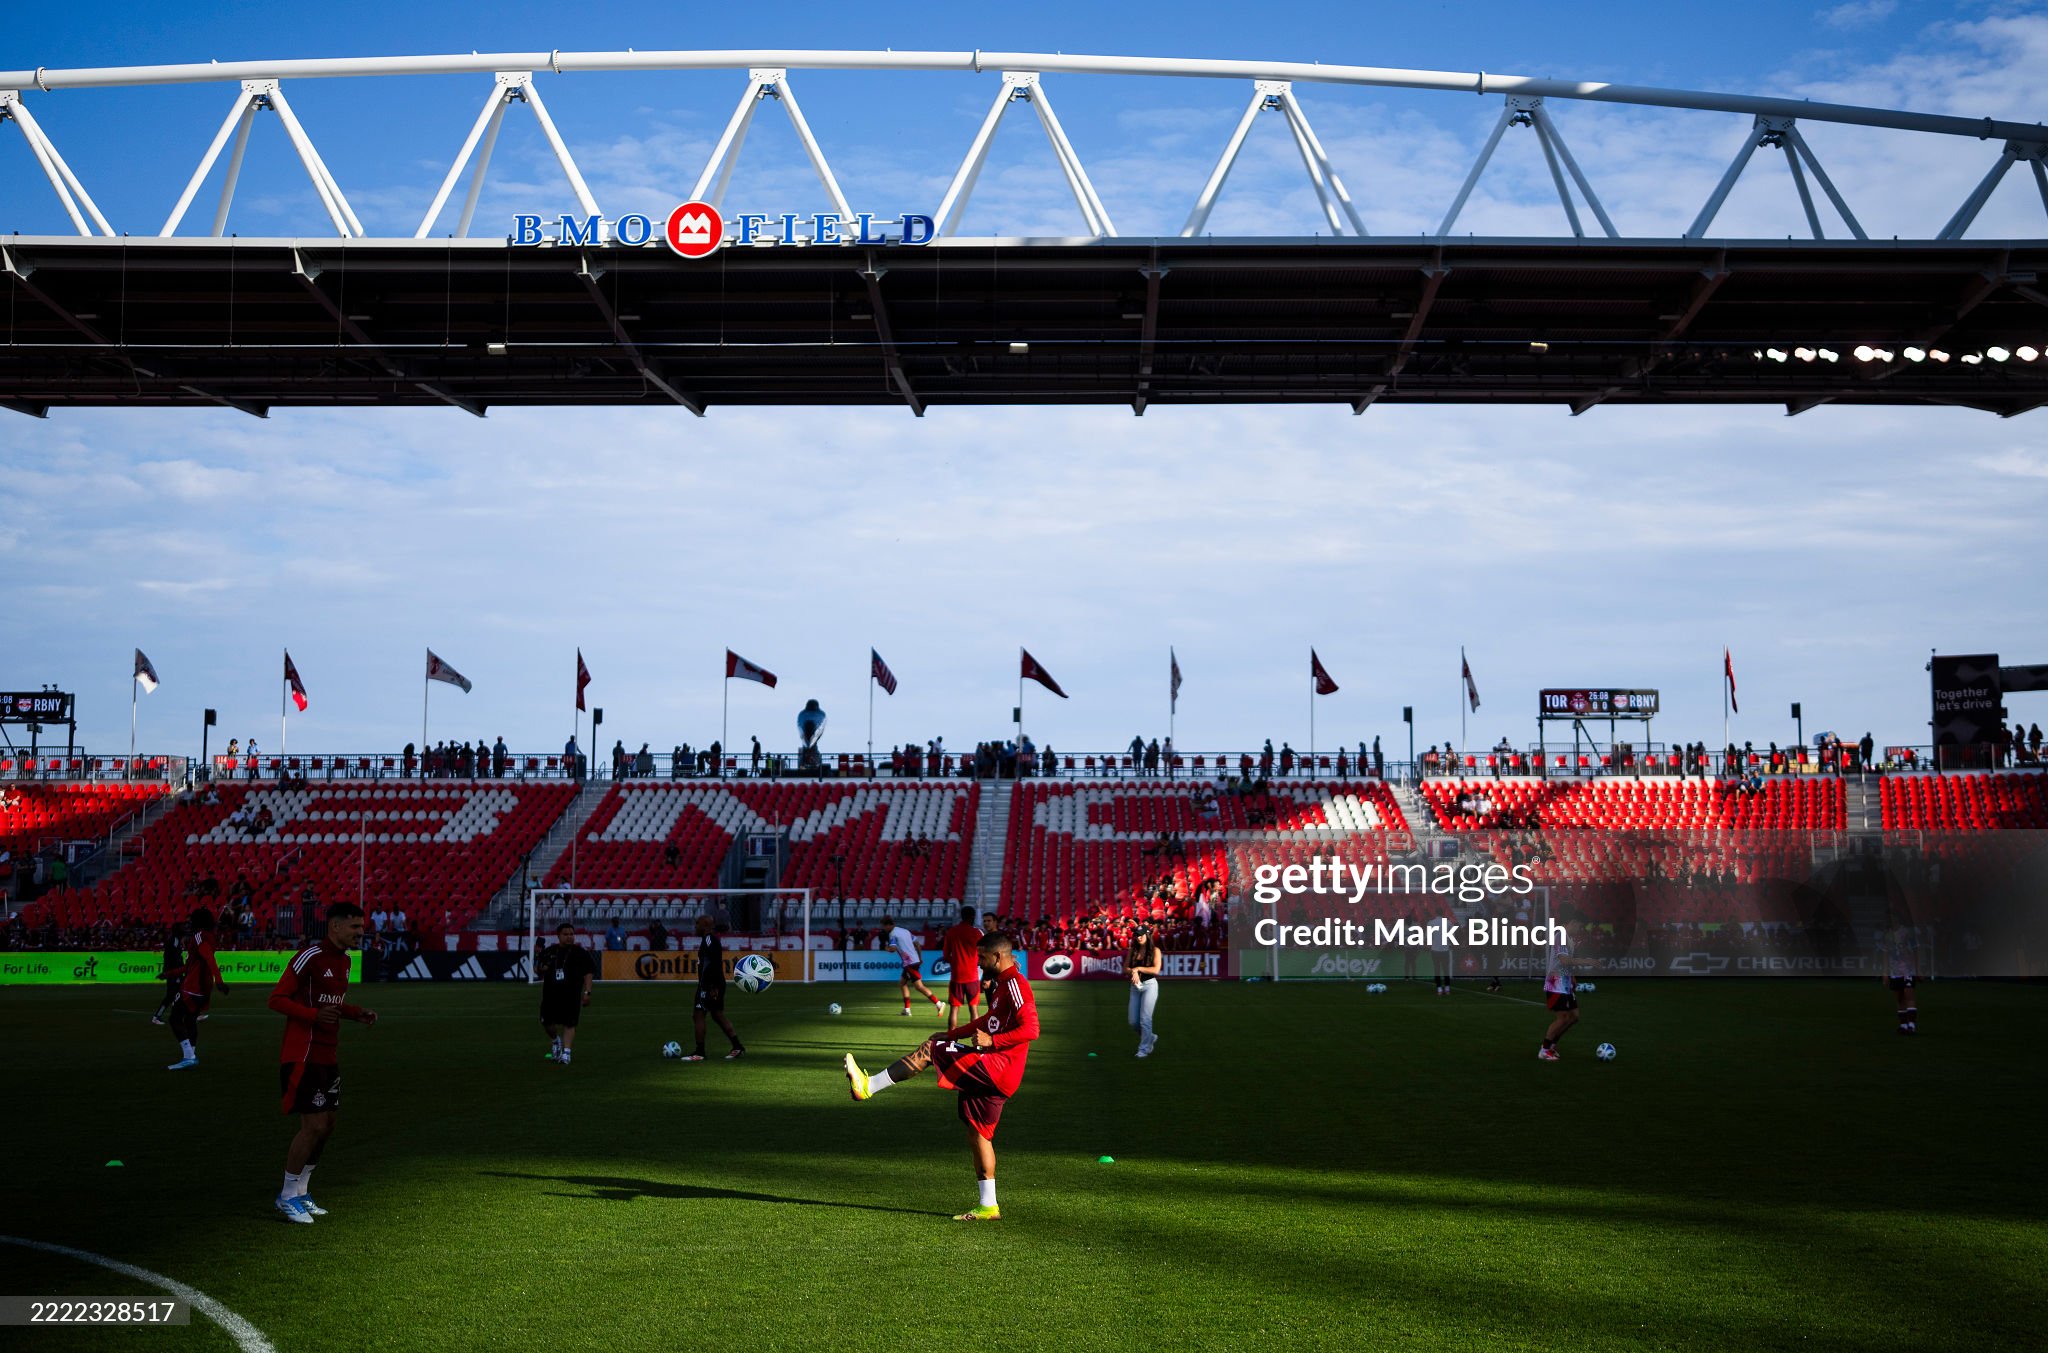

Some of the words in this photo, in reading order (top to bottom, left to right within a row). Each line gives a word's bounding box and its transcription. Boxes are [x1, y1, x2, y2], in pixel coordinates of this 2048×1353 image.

[513, 213, 653, 247] BMO
[736, 213, 936, 247] FIELD
[1936, 687, 1989, 700] Together
[34, 698, 61, 711] RBNY
[1544, 694, 1568, 708] TOR
[1629, 694, 1656, 708] RBNY
[1936, 700, 1960, 711] let's
[1962, 699, 1993, 710] drive
[4, 963, 23, 975] For
[73, 959, 97, 977] GFL
[118, 962, 154, 974] Green
[236, 962, 255, 972] For
[818, 961, 843, 972] ENJOY
[1081, 955, 1123, 974] PRINGLES
[1310, 952, 1382, 976] Sobeys
[1736, 955, 1869, 970] CHEVROLET
